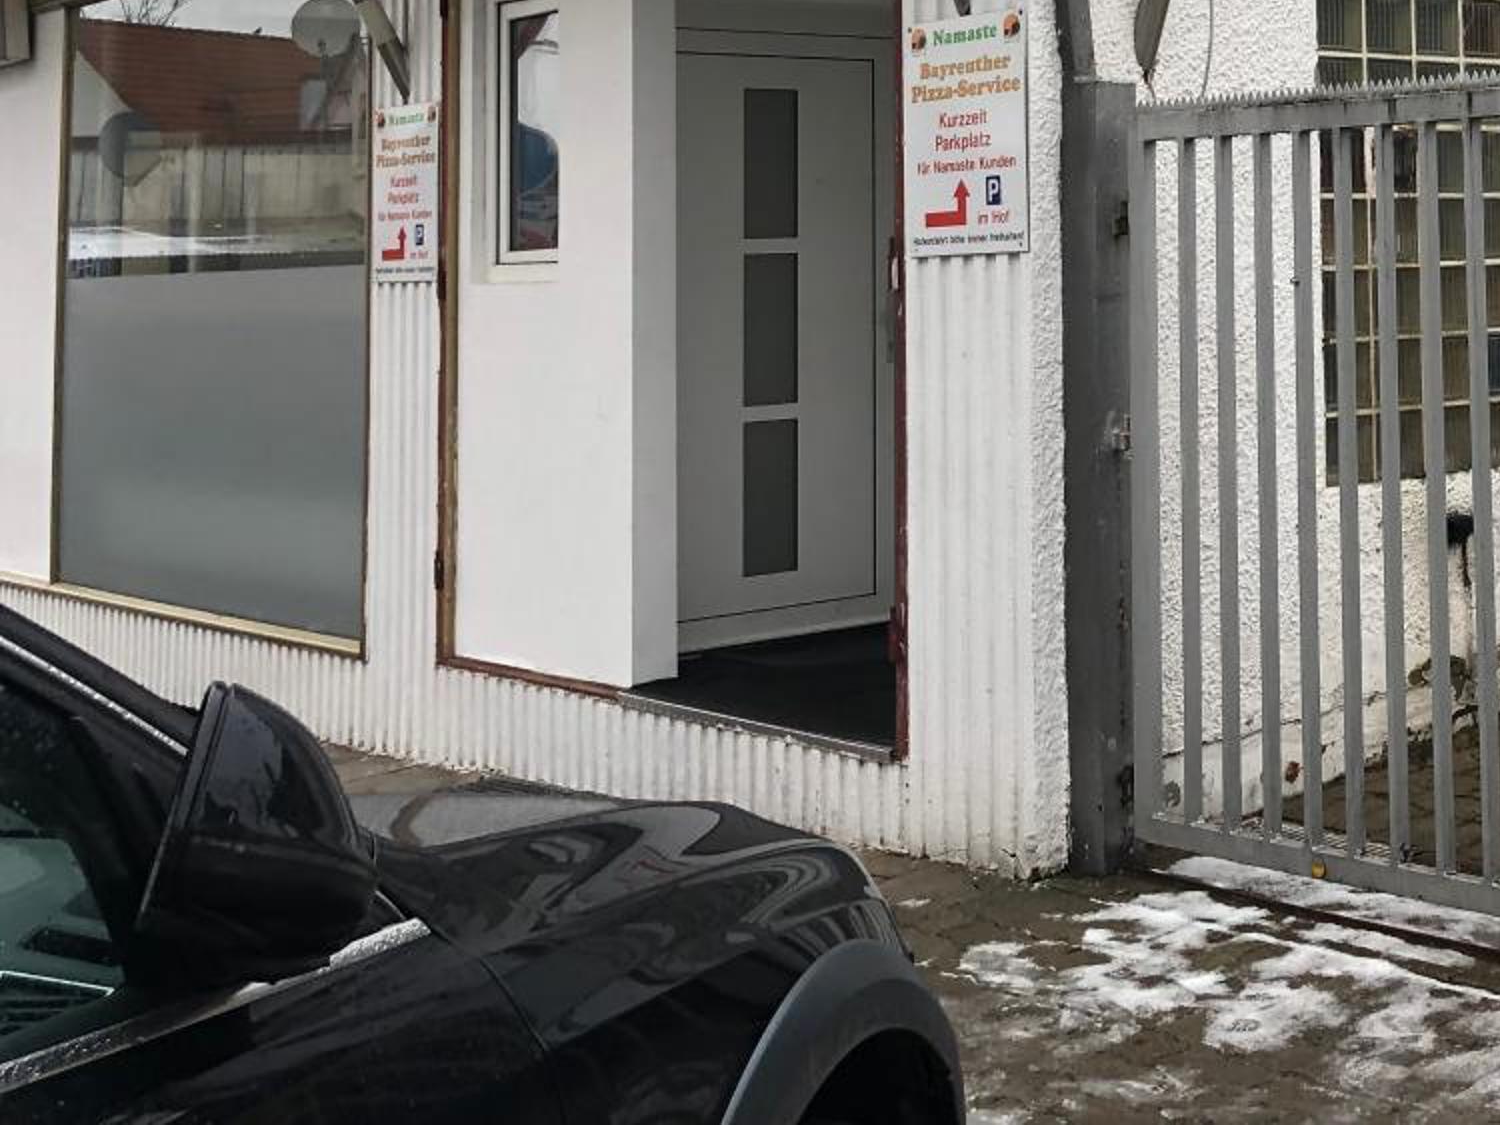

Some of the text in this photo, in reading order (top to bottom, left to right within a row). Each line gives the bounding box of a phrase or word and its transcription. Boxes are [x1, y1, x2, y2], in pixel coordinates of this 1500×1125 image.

[933, 25, 998, 47] Namaste
[920, 56, 1012, 81] Bayreuther
[911, 77, 1021, 104] Pizza-Service
[940, 109, 988, 129] Kurzzeit
[935, 131, 992, 153] Parkplatz
[933, 159, 975, 174] Namaste
[979, 155, 1017, 170] Kunden
